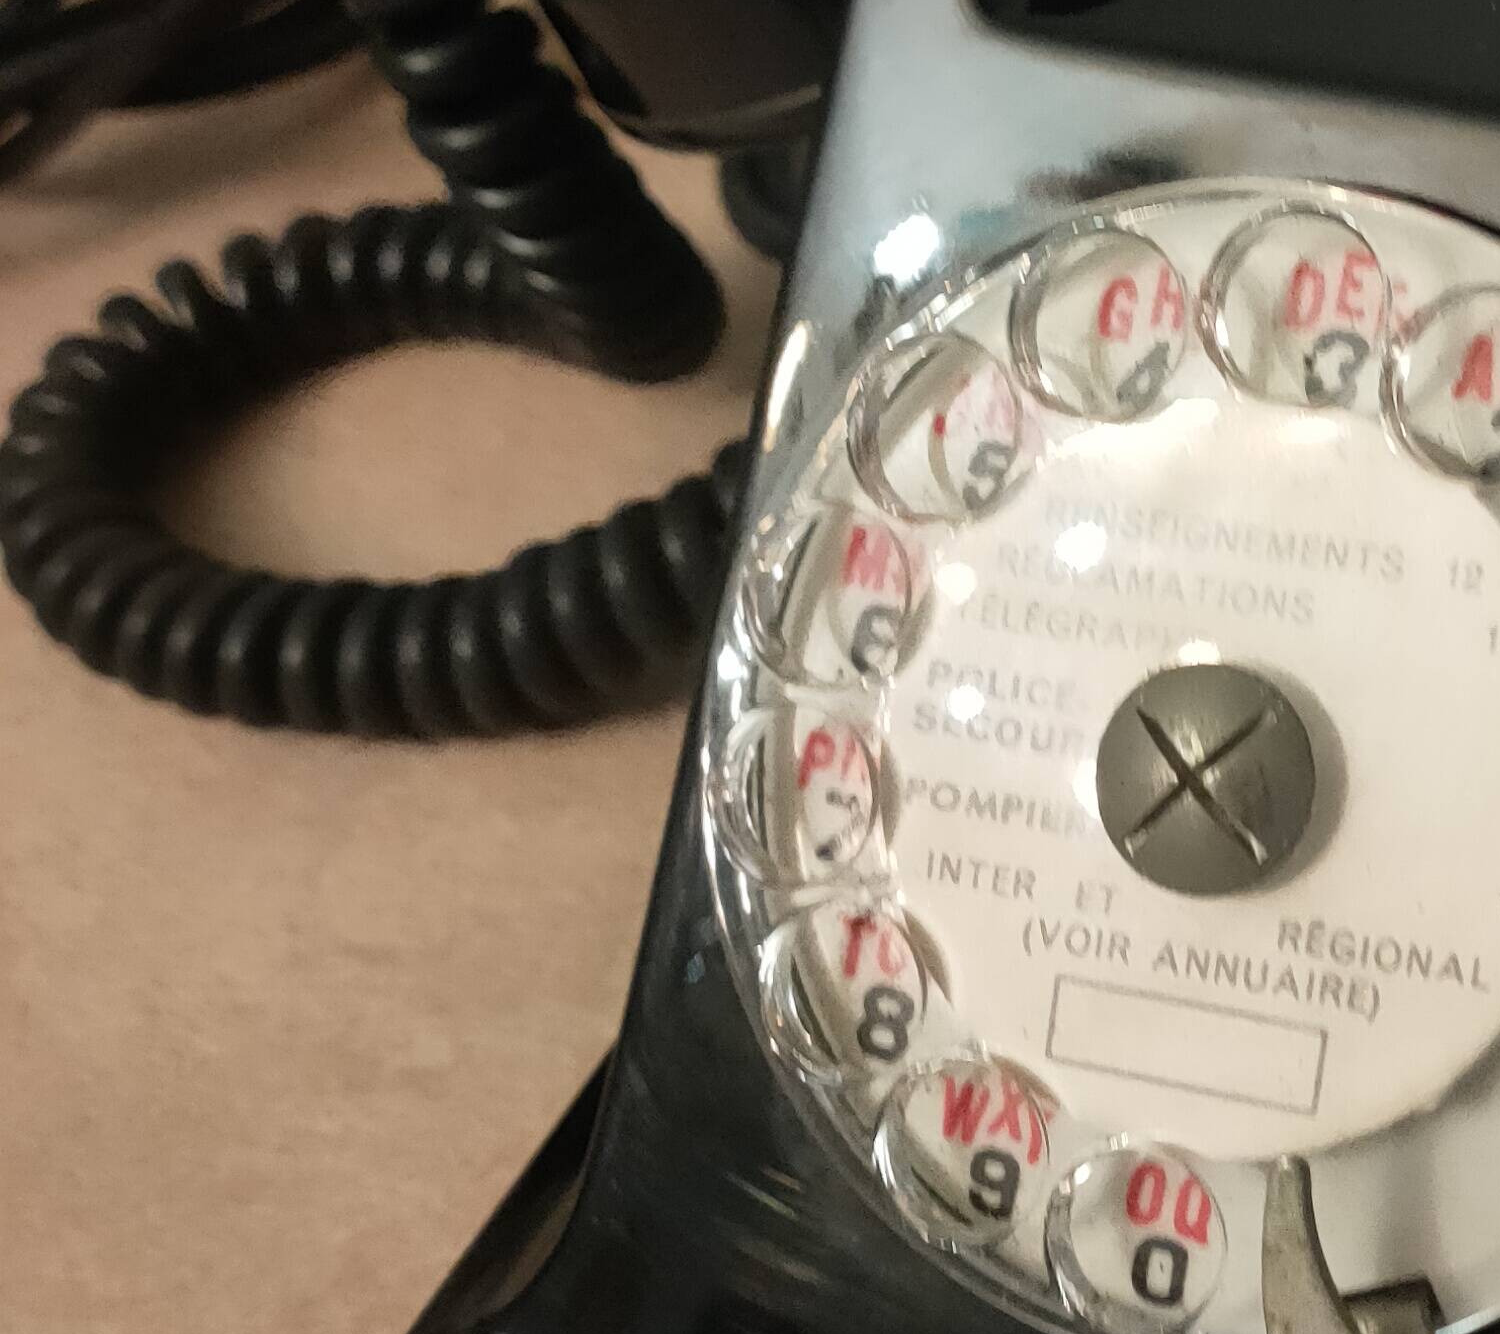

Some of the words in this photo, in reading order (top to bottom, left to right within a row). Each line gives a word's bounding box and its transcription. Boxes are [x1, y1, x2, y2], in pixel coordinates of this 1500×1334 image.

[1116, 342, 1170, 409] 4
[1304, 329, 1370, 408] 3
[1448, 556, 1483, 594] 12
[851, 604, 903, 675] 6
[927, 848, 1037, 899] INTER
[1076, 878, 1117, 914] ET
[1022, 917, 1130, 966] (VOIR
[1153, 940, 1381, 1024] ANNUAIRE)
[856, 986, 914, 1063] 8
[942, 1074, 1056, 1166] WXY
[969, 1148, 1021, 1219] 9
[1126, 1161, 1211, 1246] OQ
[1132, 1237, 1189, 1306] 0
